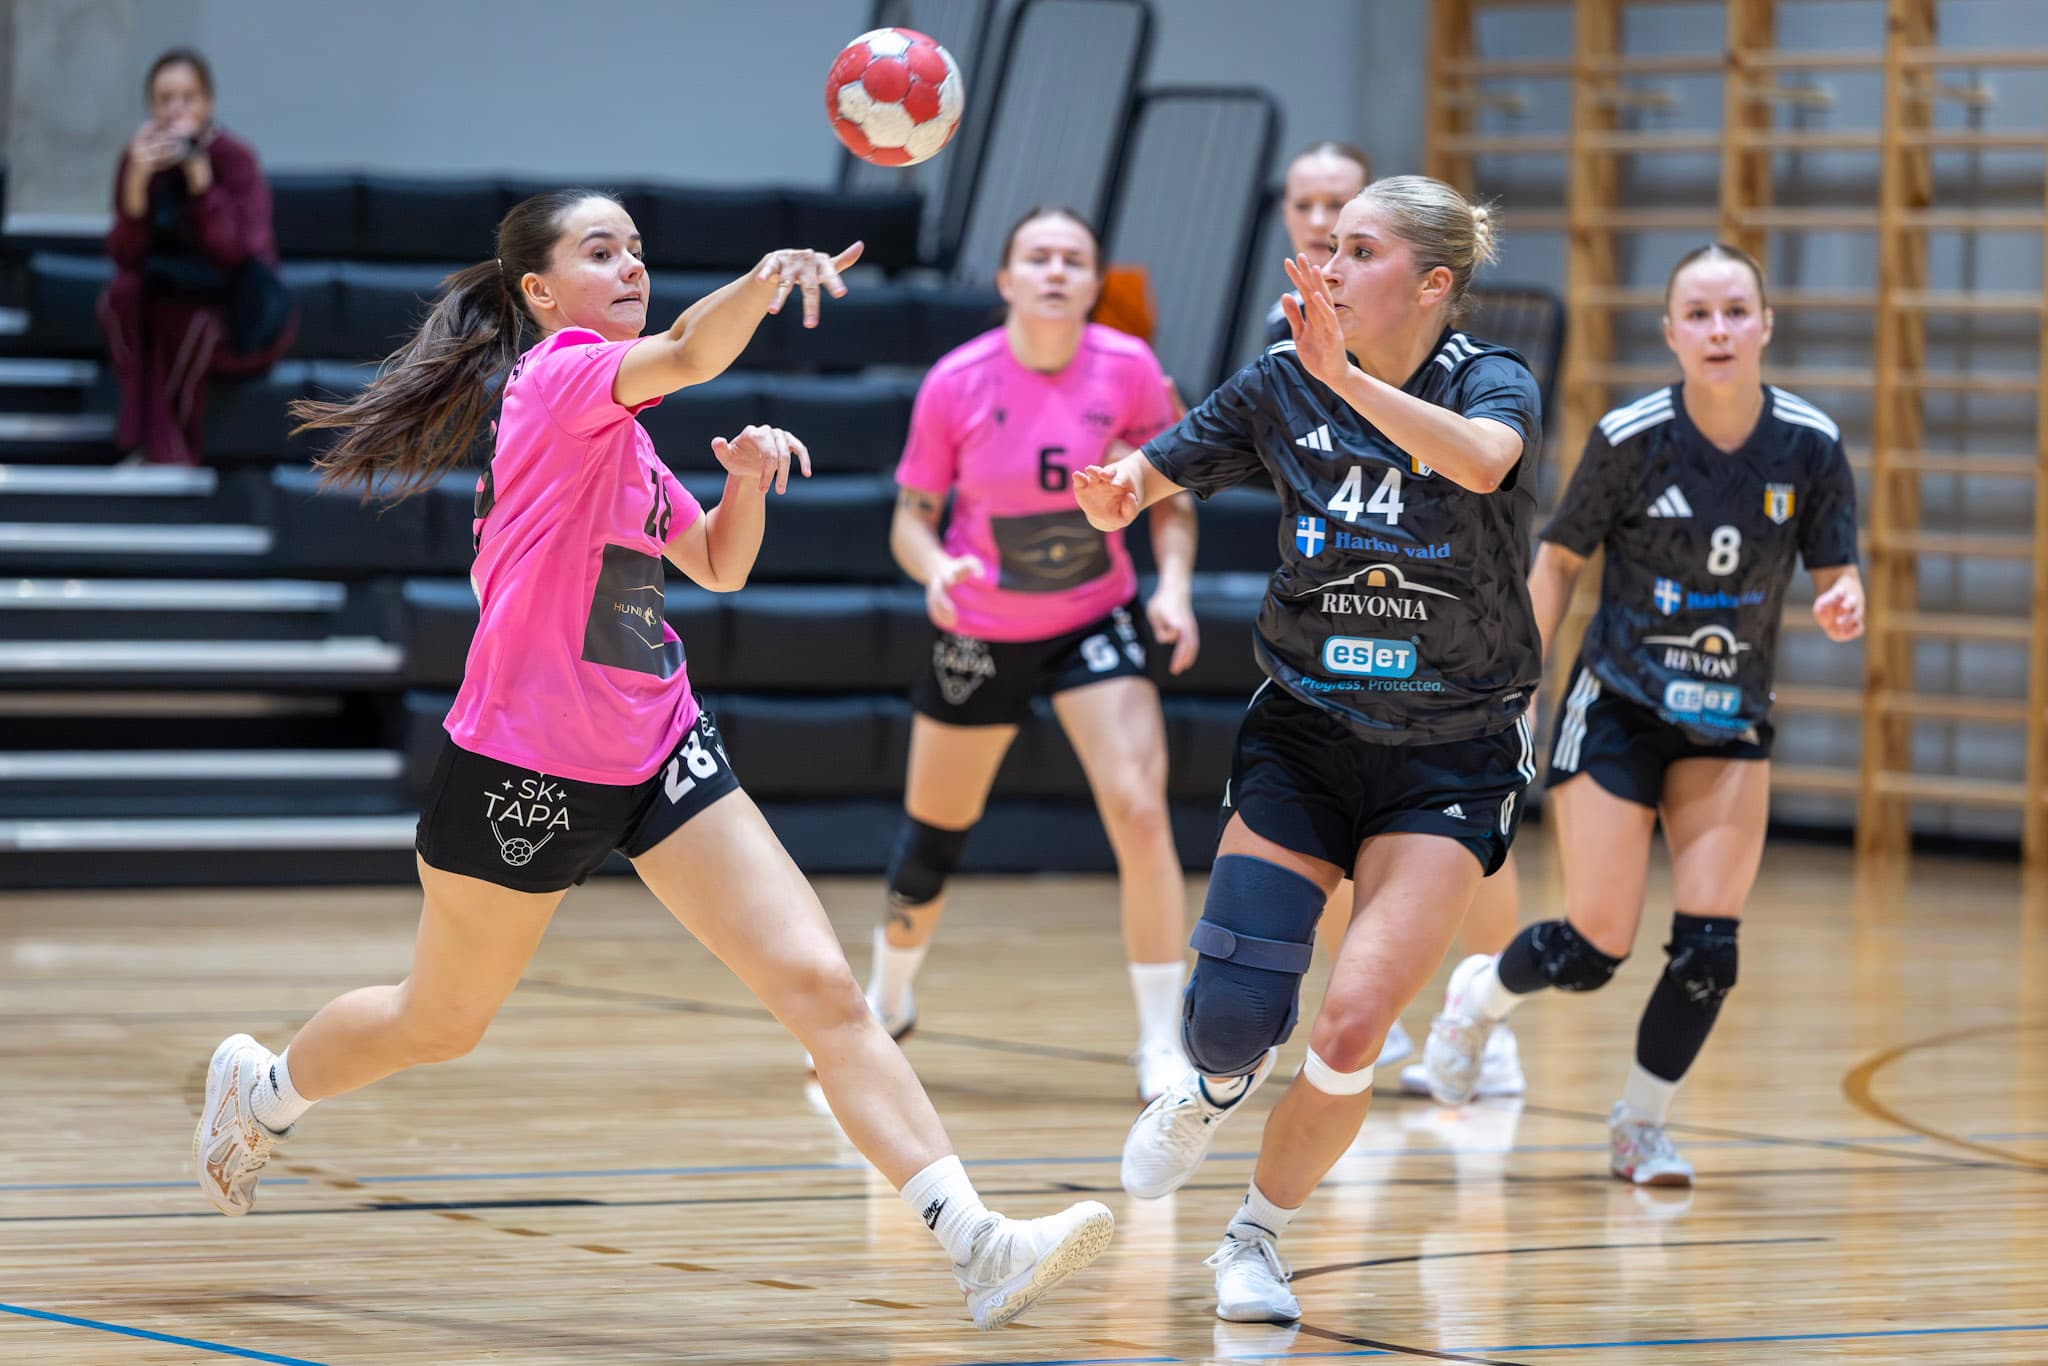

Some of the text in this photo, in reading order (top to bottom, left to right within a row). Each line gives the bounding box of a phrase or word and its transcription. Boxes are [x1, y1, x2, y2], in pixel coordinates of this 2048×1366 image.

[1037, 445, 1069, 493] 6
[1328, 465, 1404, 525] 44
[1334, 531, 1451, 560] Harku vald
[1706, 525, 1742, 576] 8
[1320, 592, 1428, 620] REVONIA
[660, 730, 718, 805] 28
[484, 791, 570, 831] TAPA
[518, 779, 558, 803] SK
